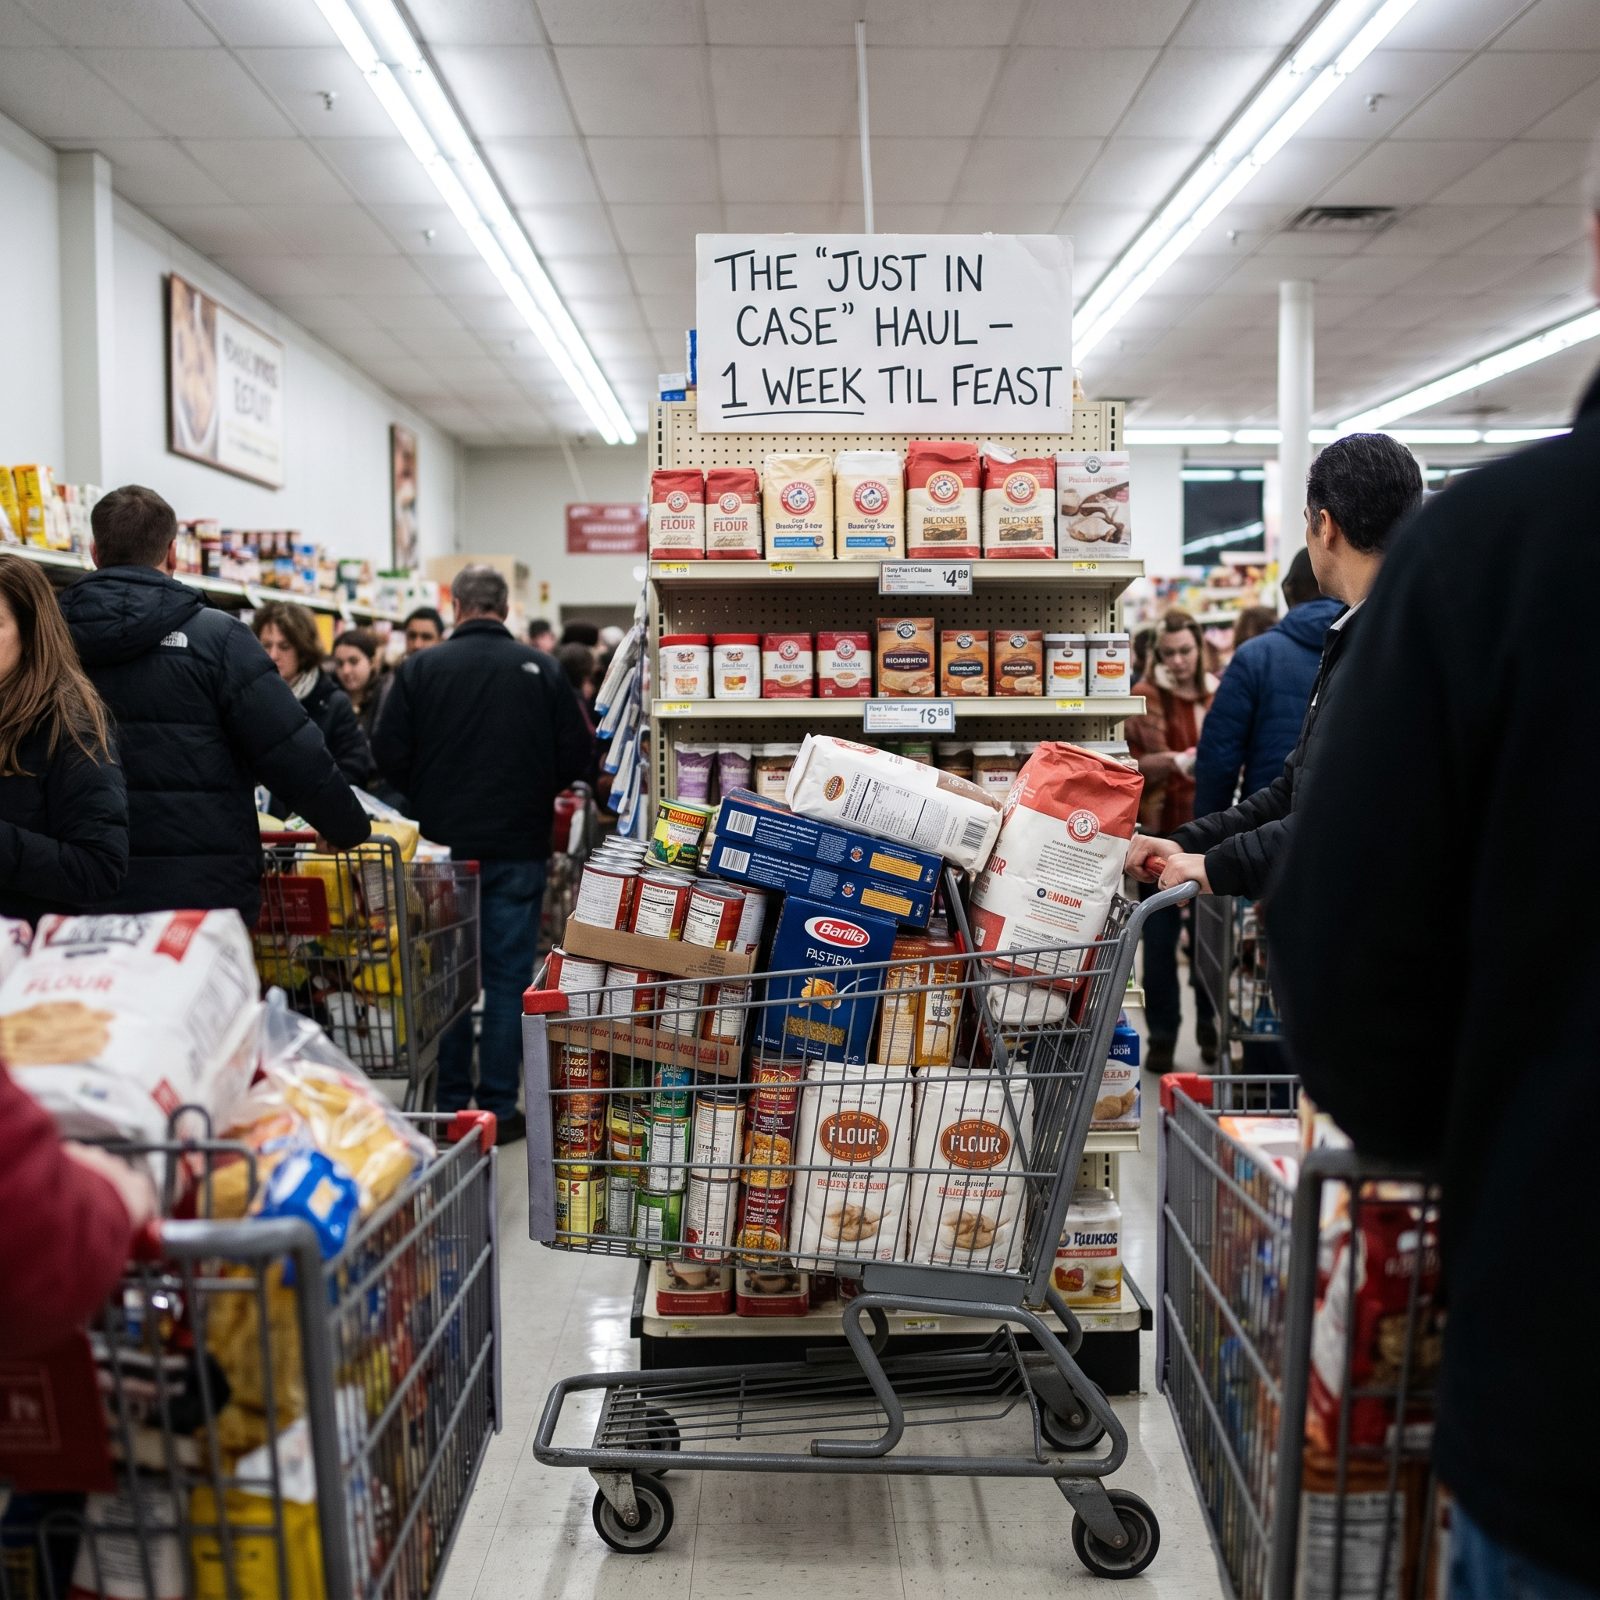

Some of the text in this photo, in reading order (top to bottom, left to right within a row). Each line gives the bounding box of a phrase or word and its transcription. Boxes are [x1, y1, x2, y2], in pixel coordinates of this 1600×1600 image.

[714, 246, 984, 293] THE “JUST IN
[736, 302, 854, 347] CASE”
[876, 306, 979, 347] HAUL
[721, 361, 1063, 409] 1 WEEK TIL FEAST
[660, 519, 696, 530] FLOUR
[713, 521, 748, 532] FLOUR
[818, 922, 866, 943] Barilla
[23, 974, 114, 996] FLOUR
[828, 1126, 880, 1146] FLOUR
[950, 1134, 1001, 1154] FLOUR
